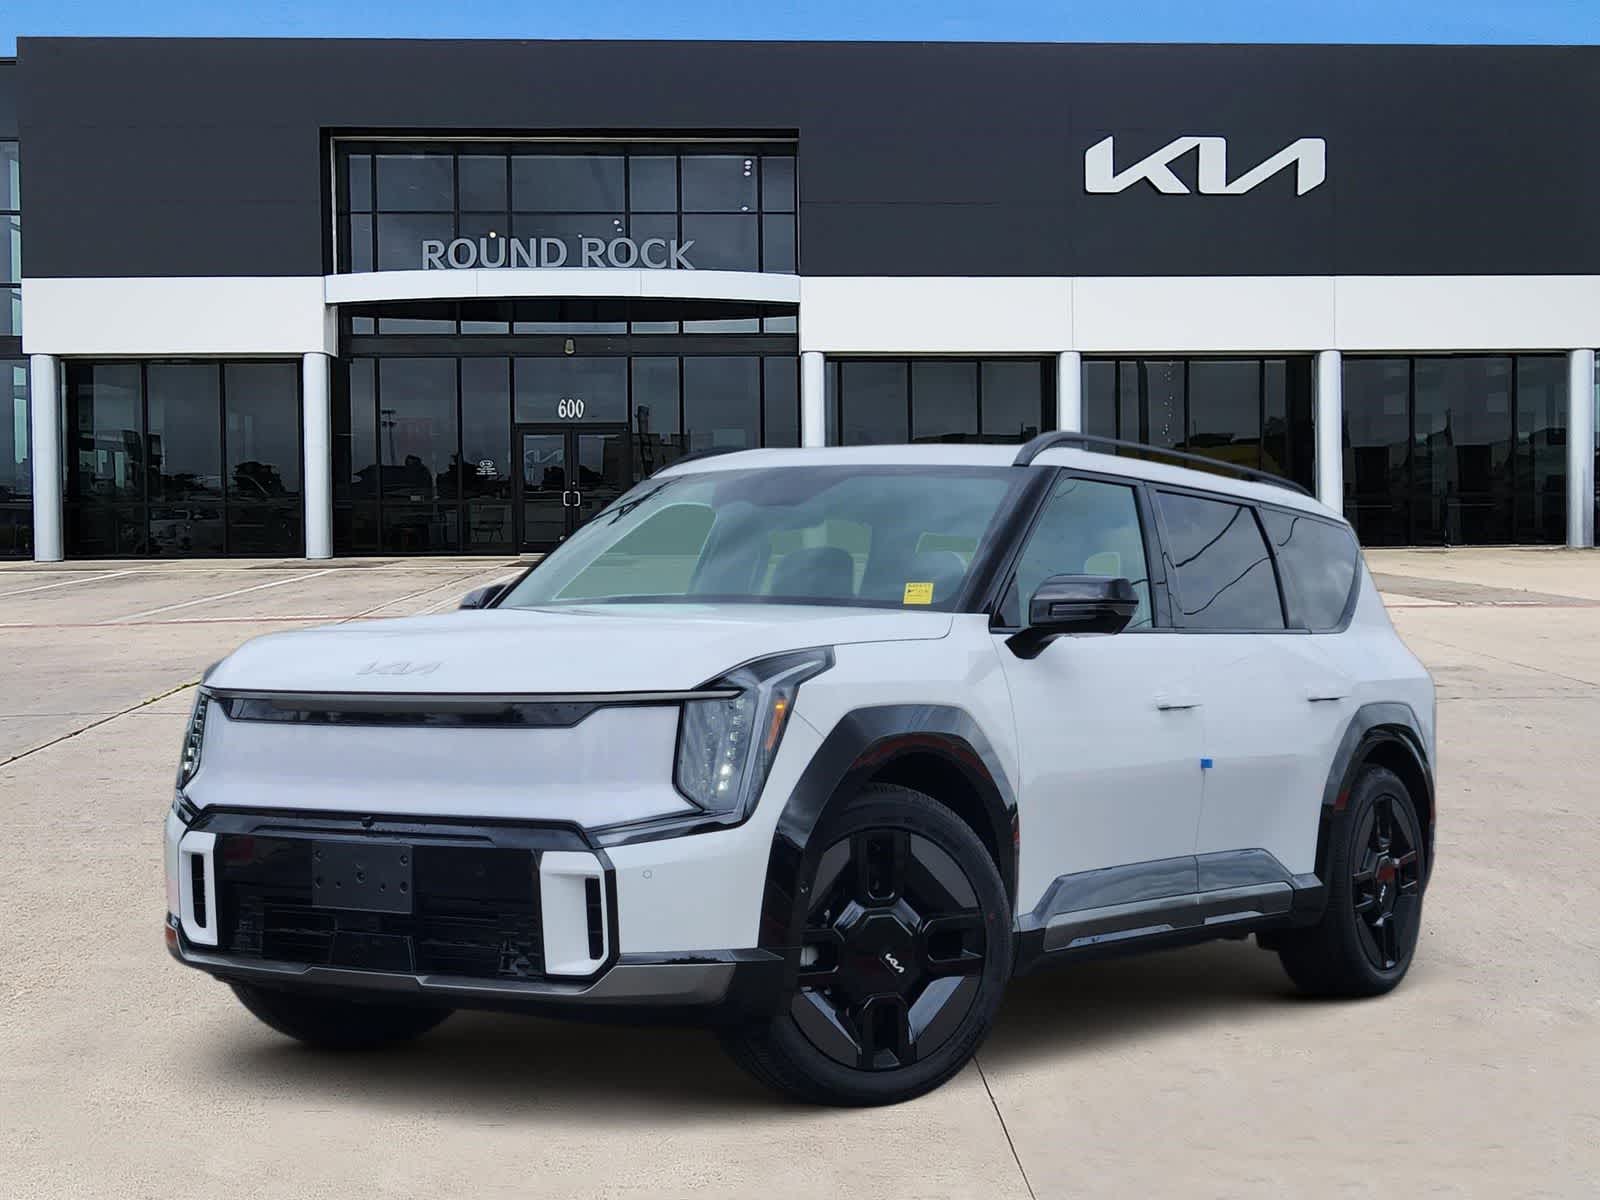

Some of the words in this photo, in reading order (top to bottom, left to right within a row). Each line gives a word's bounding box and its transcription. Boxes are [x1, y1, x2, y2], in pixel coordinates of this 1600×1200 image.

[422, 237, 568, 270] ROUND
[581, 237, 696, 270] ROCK
[558, 399, 584, 418] 600
